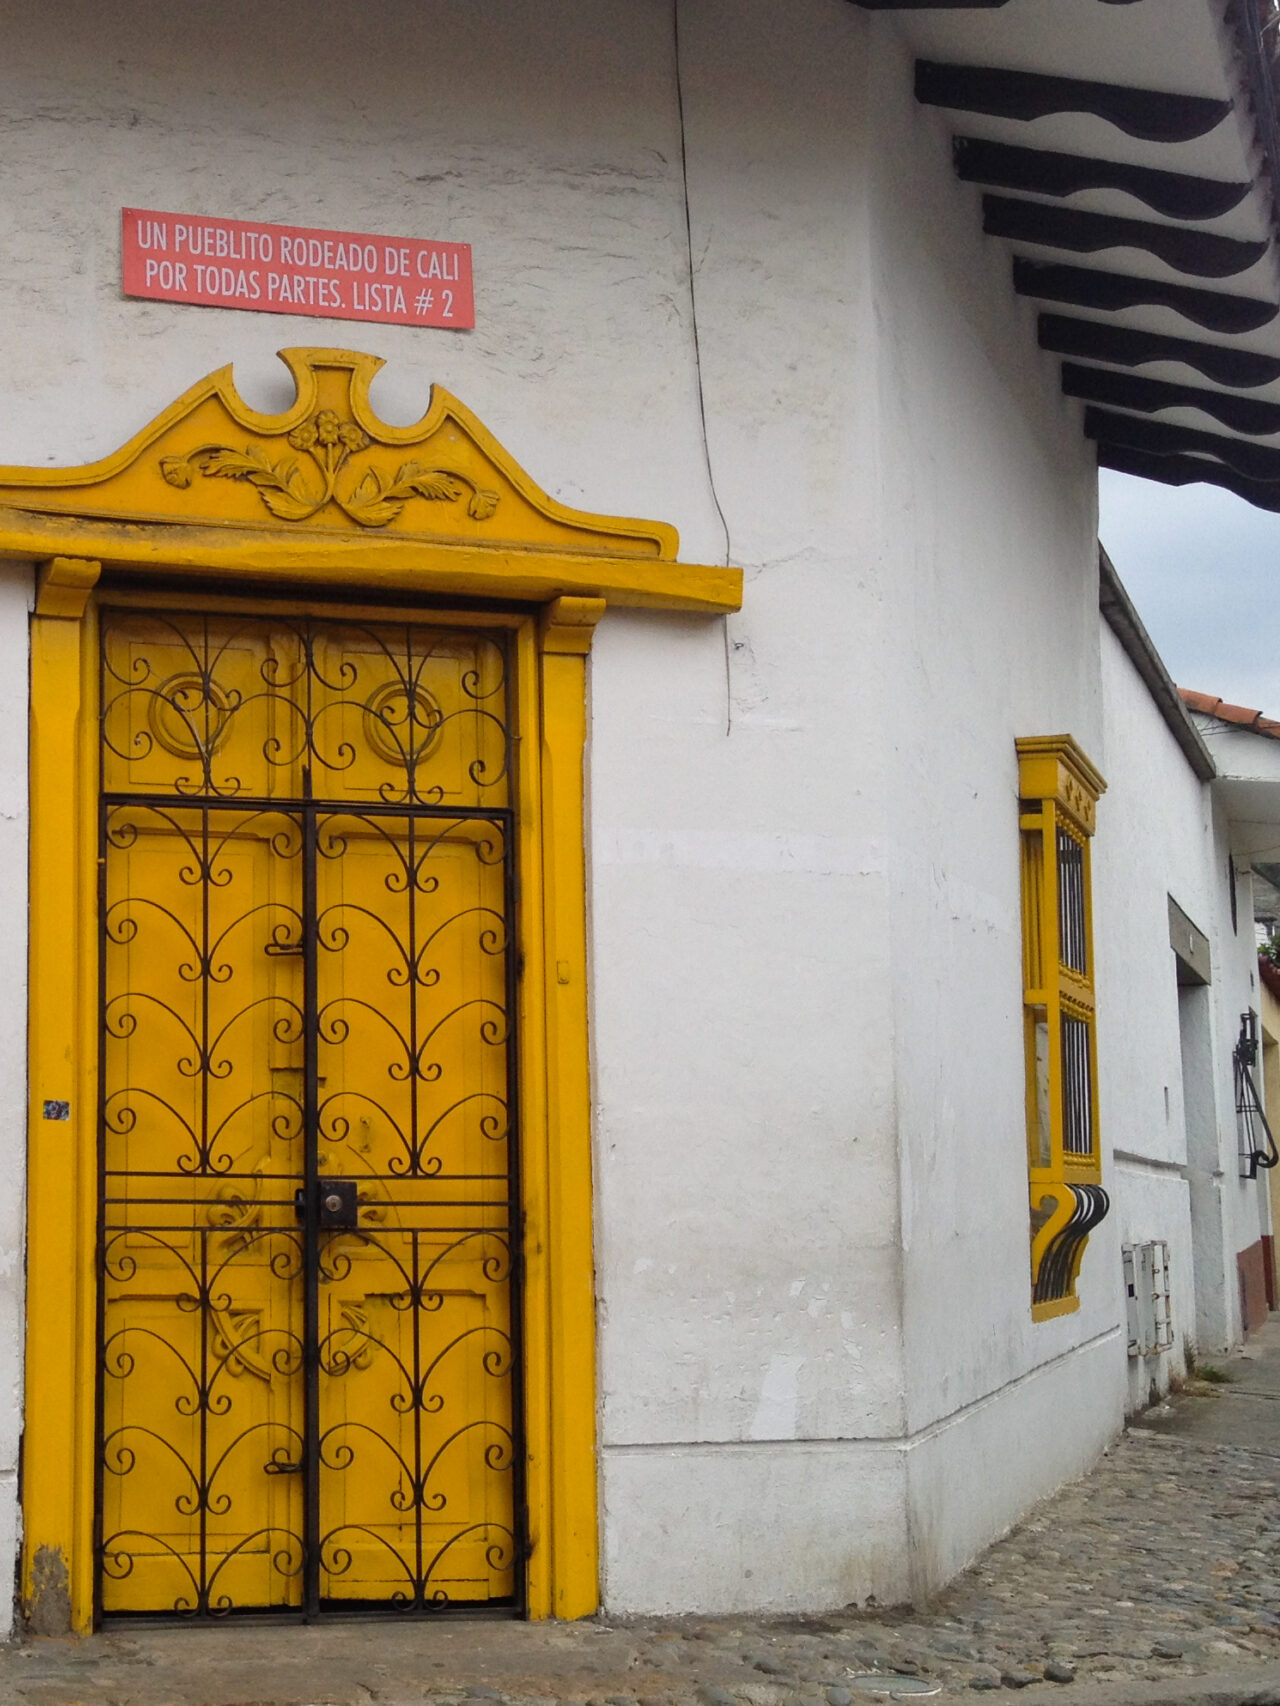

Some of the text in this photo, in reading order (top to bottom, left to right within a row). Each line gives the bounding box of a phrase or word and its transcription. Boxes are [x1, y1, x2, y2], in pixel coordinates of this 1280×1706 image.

[137, 220, 459, 280] UN PUEBLITO RODEADO DE CALI
[146, 259, 454, 318] POR TODAS PARTES. LISTA # 2
